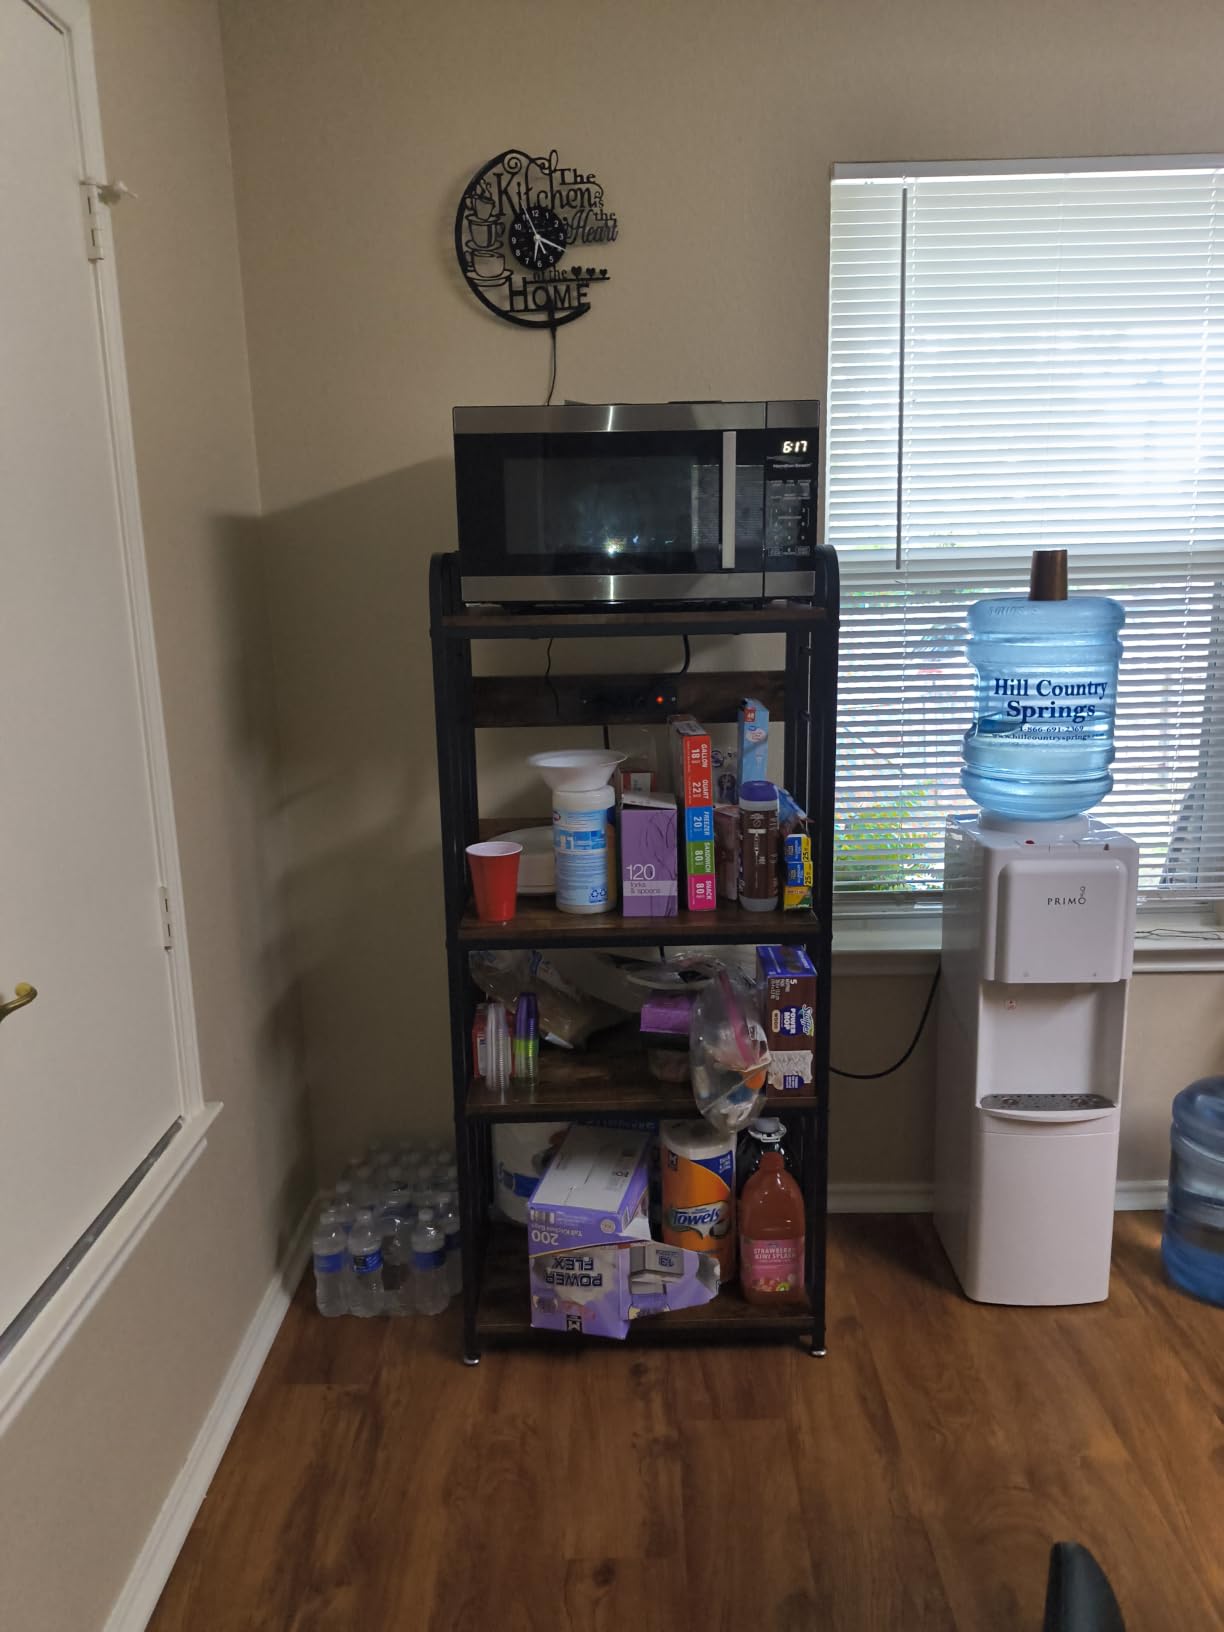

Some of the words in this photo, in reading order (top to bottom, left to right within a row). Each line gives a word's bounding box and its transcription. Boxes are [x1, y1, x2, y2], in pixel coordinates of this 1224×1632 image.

[493, 150, 594, 216] Kitchen
[558, 168, 596, 185] The
[593, 209, 616, 221] the
[514, 223, 522, 231] 10
[554, 220, 559, 228] 2
[562, 209, 619, 245] Heart
[511, 236, 517, 245] 9
[515, 249, 521, 257] 8
[524, 257, 530, 265] 7
[537, 260, 543, 268] 6
[508, 276, 591, 313] HOME
[782, 440, 808, 454] 6:17
[994, 678, 1029, 697] Hill
[1036, 679, 1108, 700] Country
[1006, 700, 1096, 724] Springs
[691, 748, 701, 759] 18
[692, 782, 702, 793] 22
[693, 816, 703, 828] 20
[694, 850, 704, 861] 80
[625, 863, 656, 880] 120
[696, 883, 705, 894] 80
[1047, 897, 1087, 905] PRIMO
[783, 1011, 791, 1030] MOP
[673, 1207, 720, 1225] Towels
[531, 1230, 560, 1246] 200
[552, 1256, 595, 1271] FLEX
[545, 1272, 603, 1287] POWER
